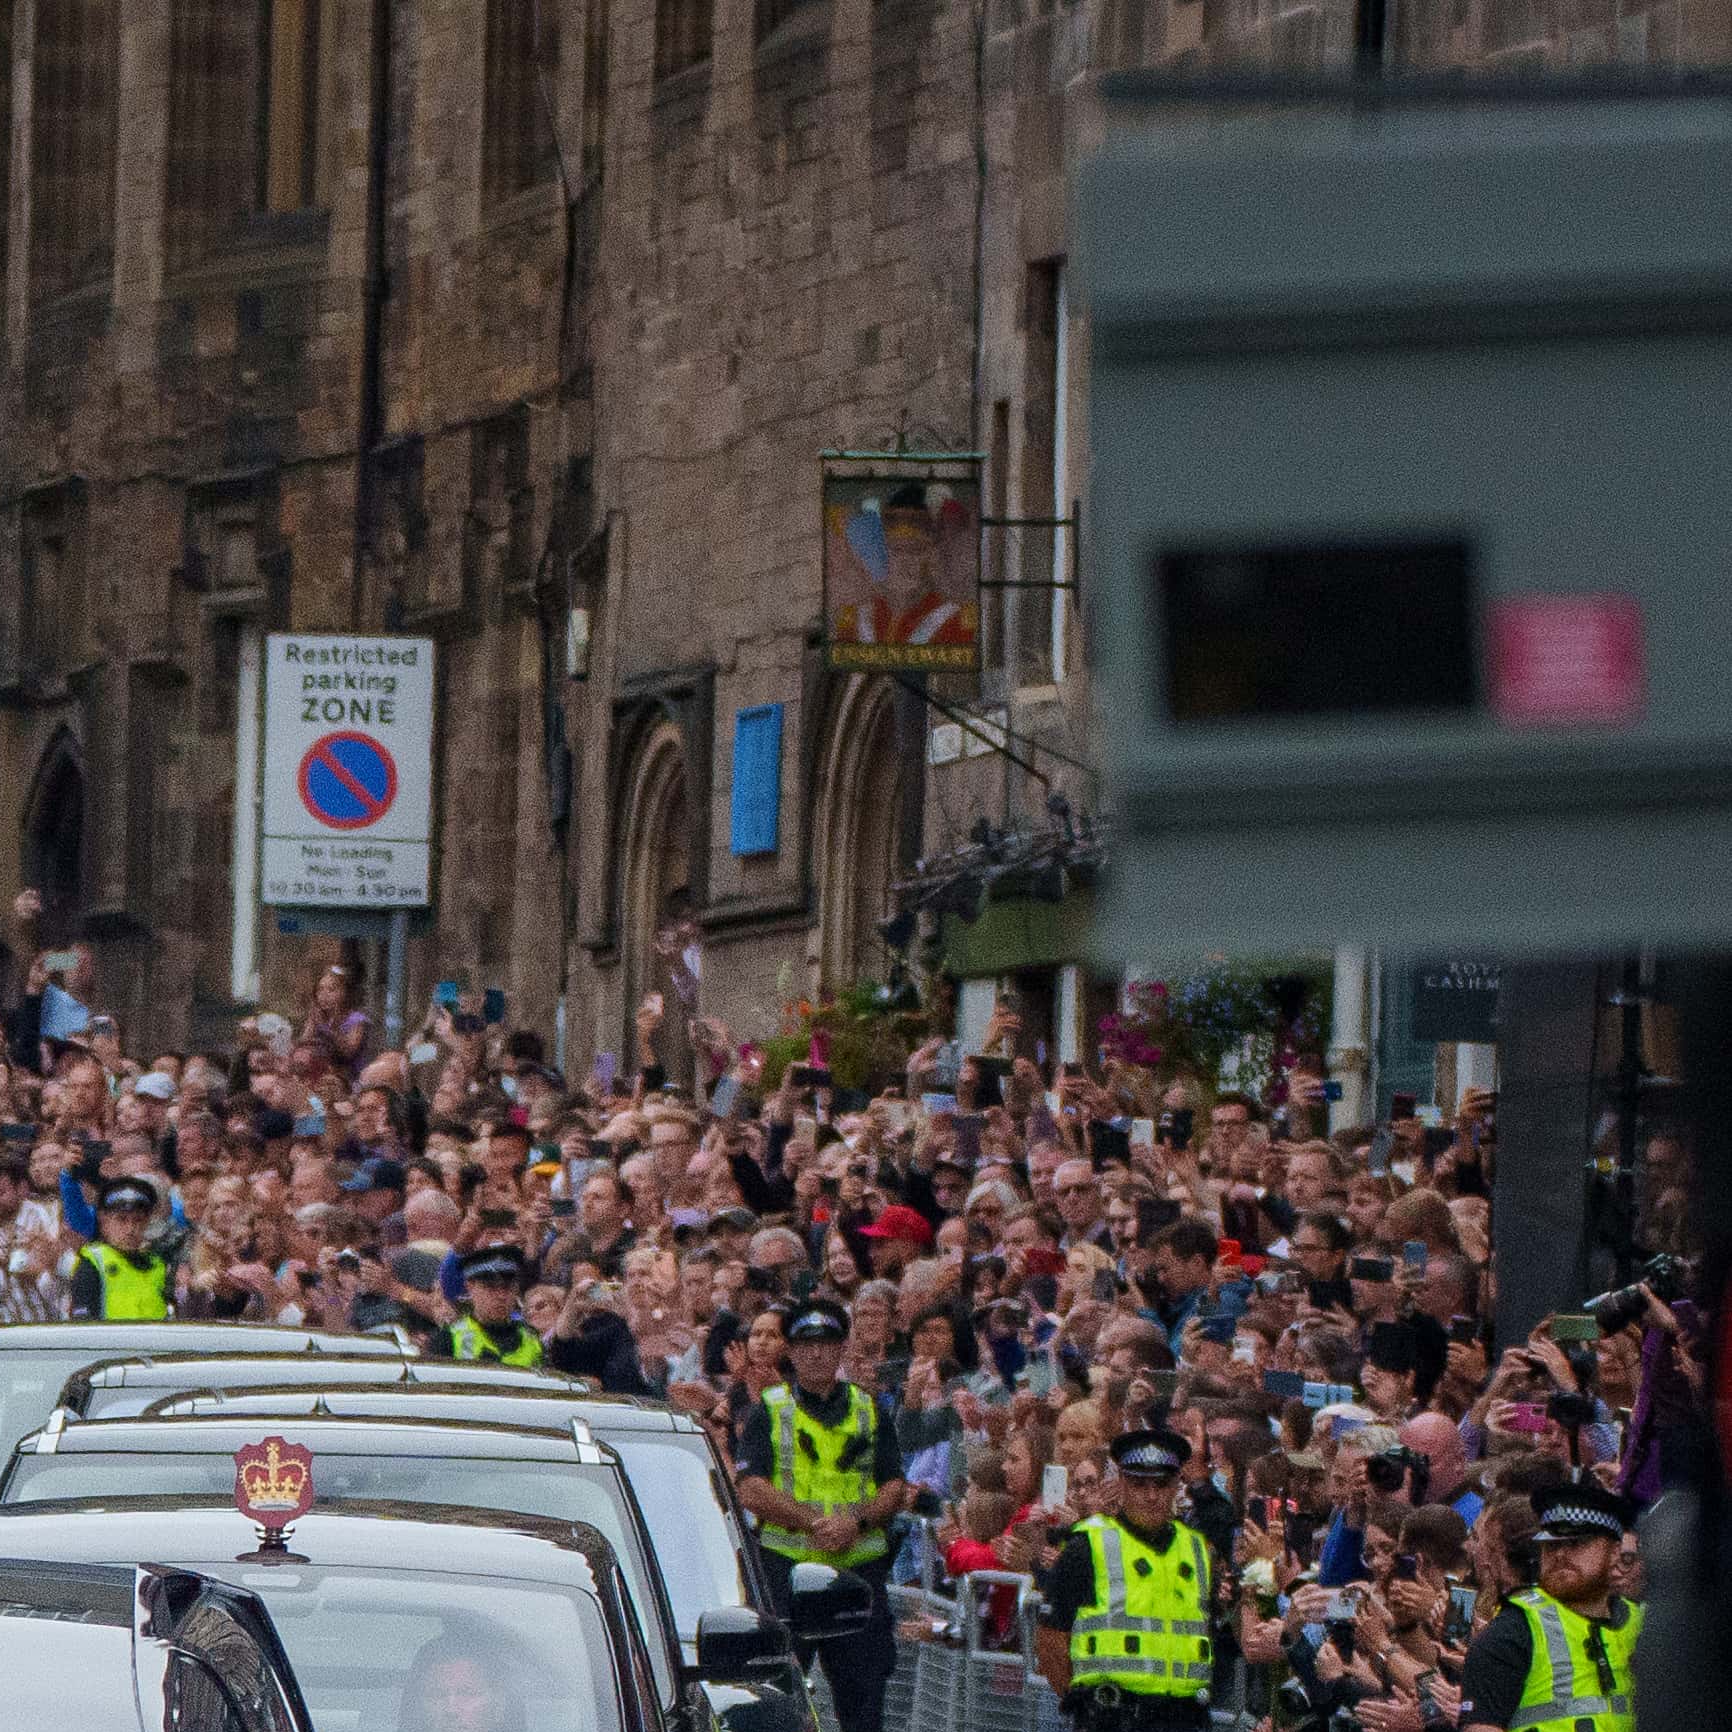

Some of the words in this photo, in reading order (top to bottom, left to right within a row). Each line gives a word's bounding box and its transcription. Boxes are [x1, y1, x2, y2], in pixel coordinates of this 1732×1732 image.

[286, 642, 418, 666] Restricted
[302, 671, 397, 694] parking
[301, 698, 395, 725] ZONE
